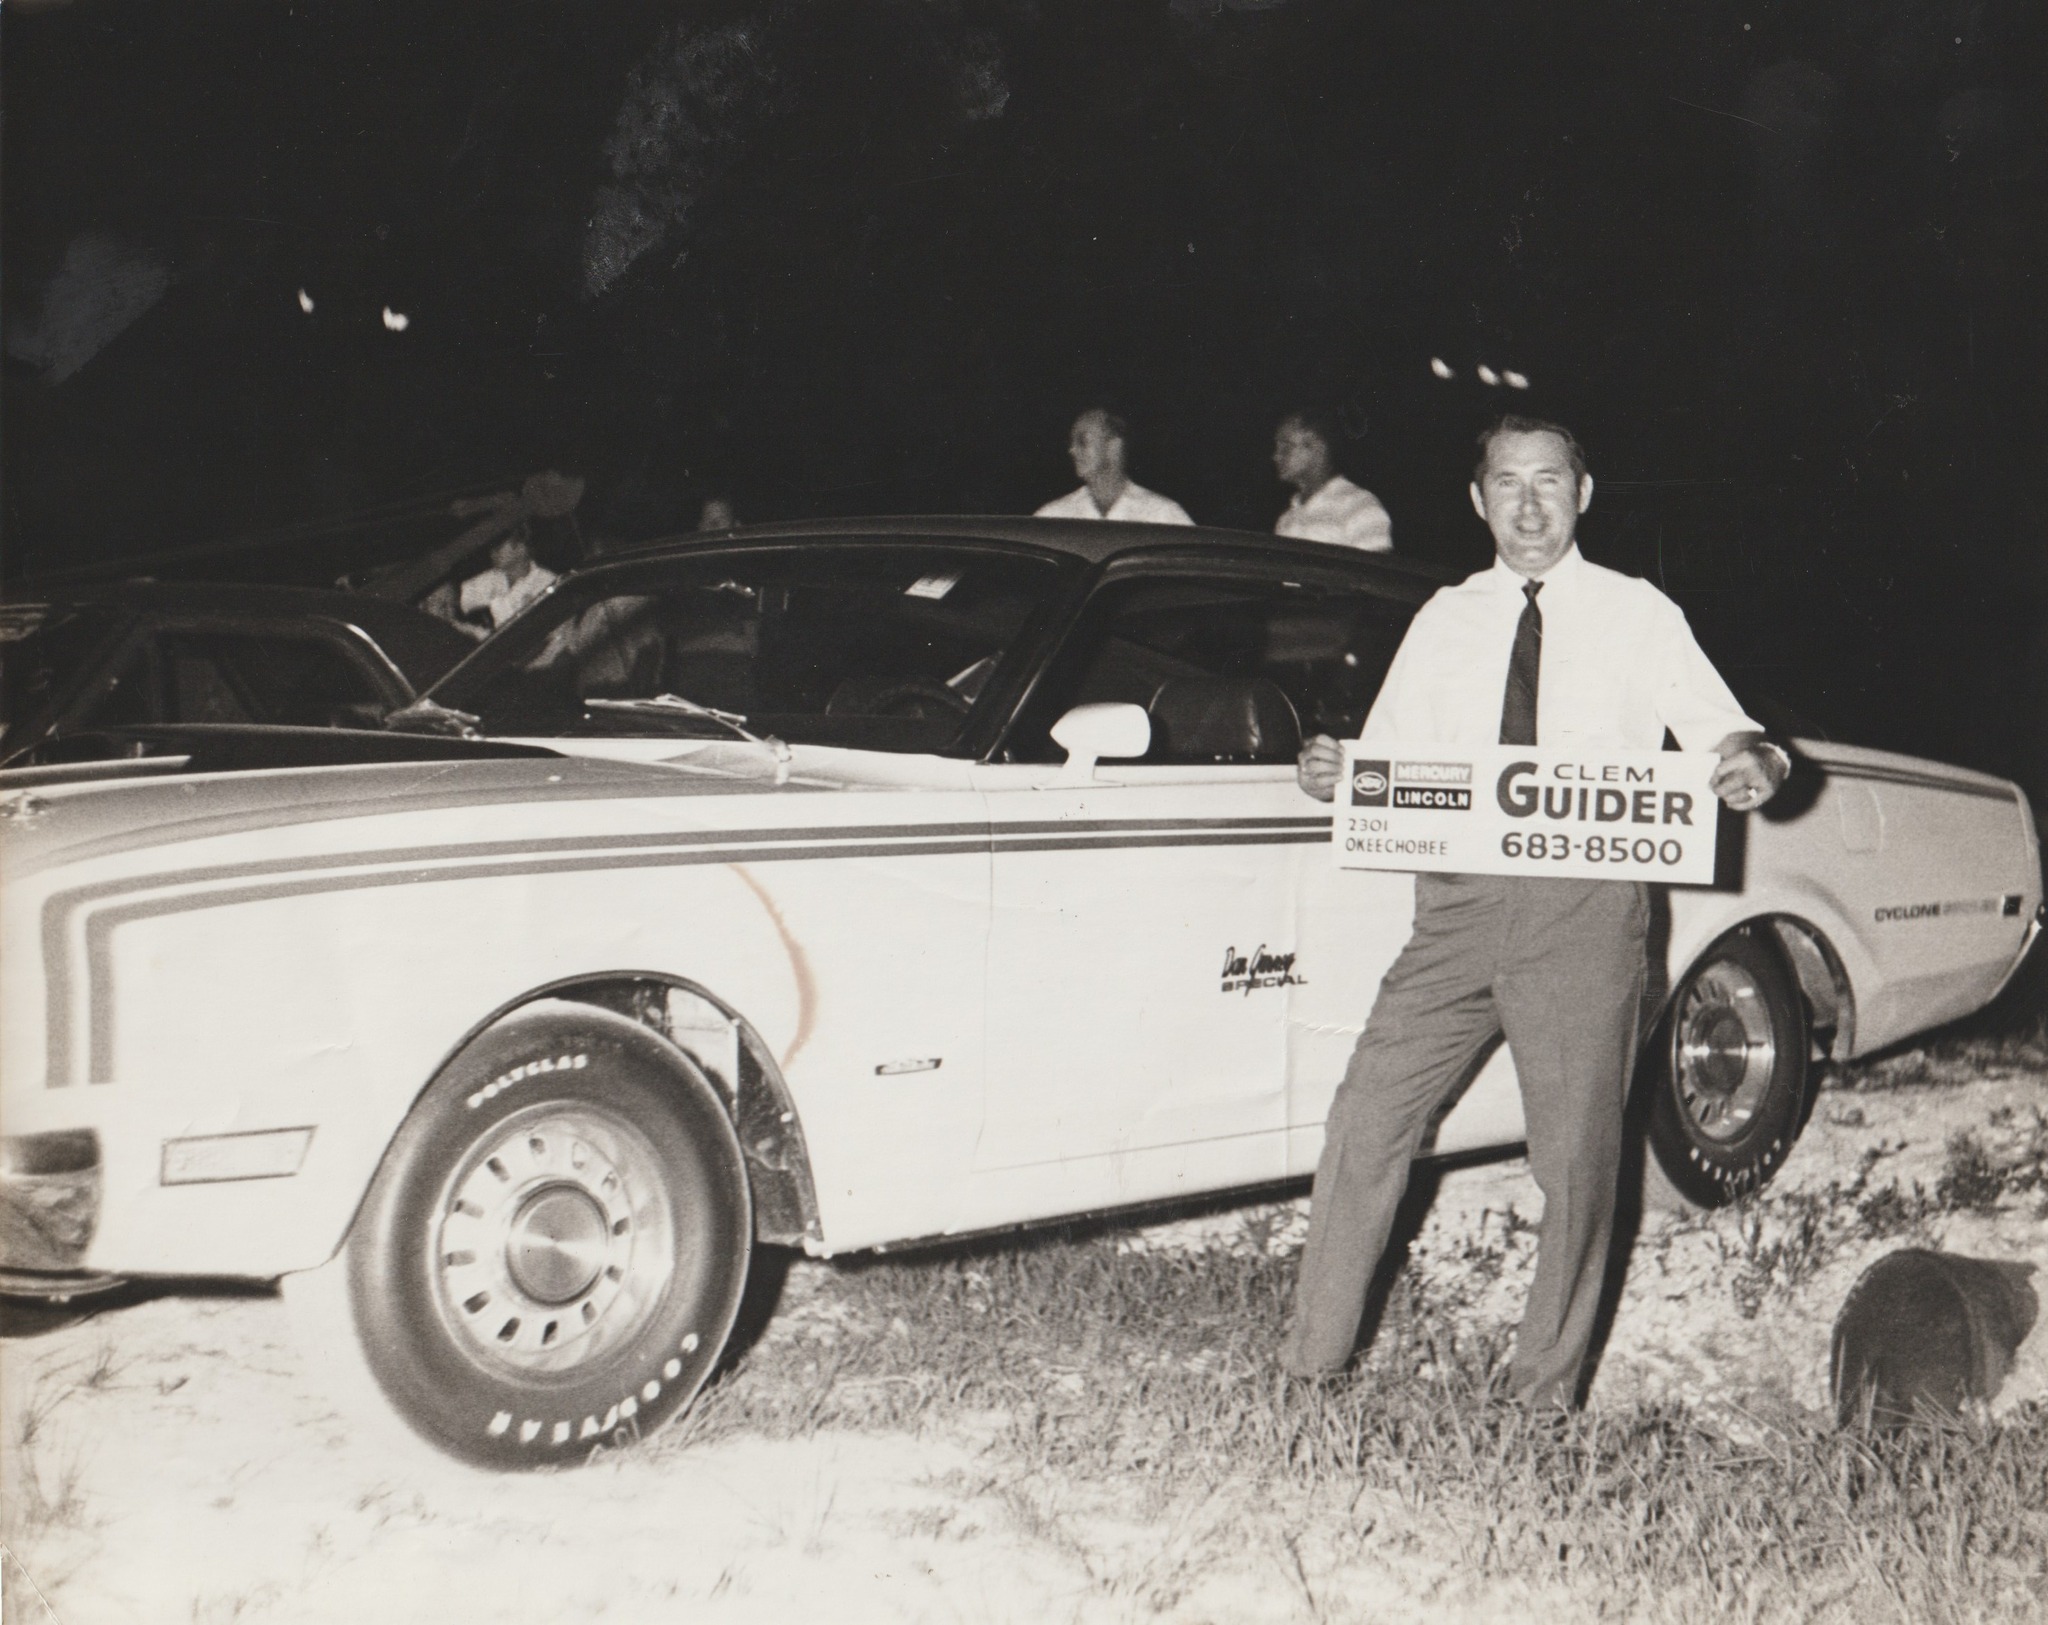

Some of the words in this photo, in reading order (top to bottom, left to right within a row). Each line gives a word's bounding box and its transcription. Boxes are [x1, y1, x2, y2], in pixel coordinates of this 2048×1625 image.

[1397, 764, 1470, 781] MERCURY
[1553, 763, 1655, 783] CLEM
[1395, 790, 1469, 807] LINCOLN
[1496, 761, 1694, 826] GUIDER
[1348, 817, 1388, 832] 2301
[1345, 836, 1448, 856] OKEECHOBEE
[1500, 831, 1683, 866] 683-8500
[1874, 903, 1941, 922] CYCLONE
[1221, 974, 1308, 992] SPECIAL
